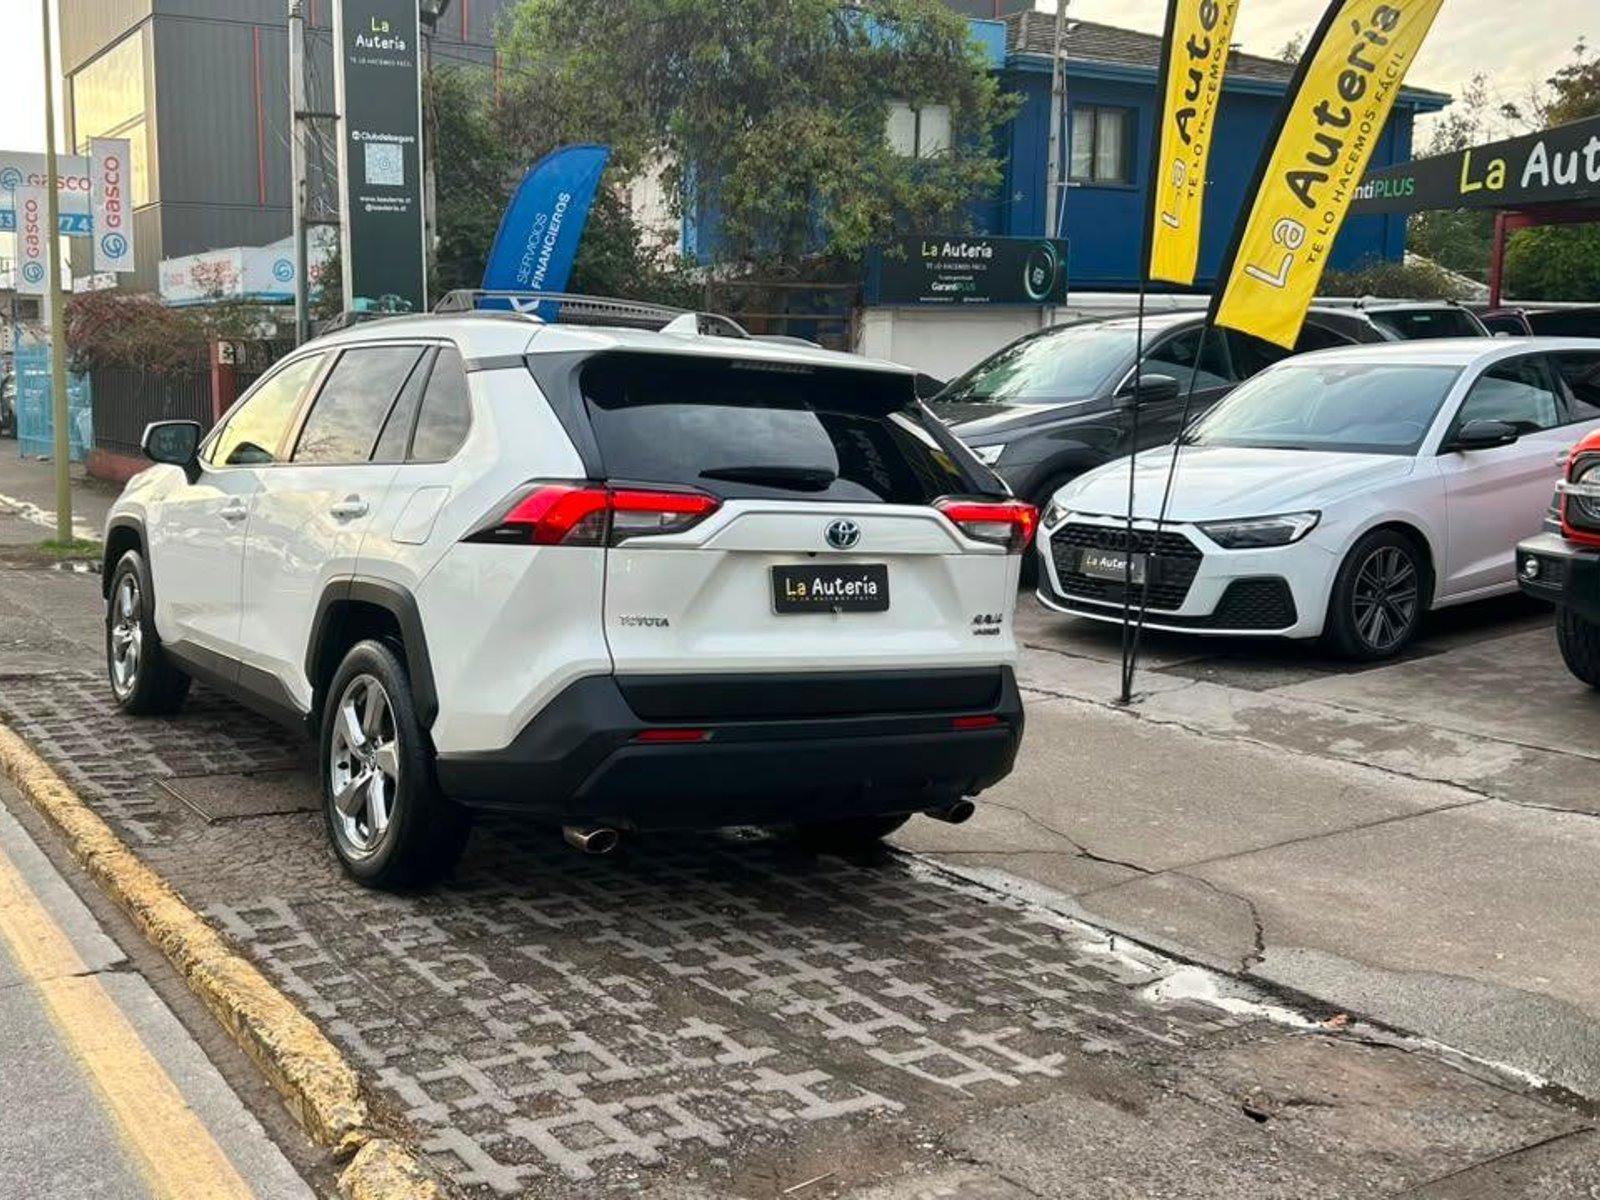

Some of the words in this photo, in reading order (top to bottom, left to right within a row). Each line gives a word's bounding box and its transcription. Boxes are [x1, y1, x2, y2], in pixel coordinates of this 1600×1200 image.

[371, 16, 389, 33] La
[1244, 217, 1307, 289] La
[1285, 3, 1401, 209] Autería
[1306, 242, 1325, 264] TE
[1318, 210, 1336, 237] LO
[1332, 108, 1377, 204] HACEMOS
[1374, 51, 1405, 103] FÁCIL
[1460, 150, 1507, 194] La
[1520, 135, 1600, 188] Aut
[516, 212, 548, 285] SERVICIOS
[531, 191, 571, 290] FINANCIEROS
[921, 241, 938, 257] La
[941, 241, 993, 258] Autería
[785, 578, 807, 596] La
[811, 575, 877, 596] Autería
